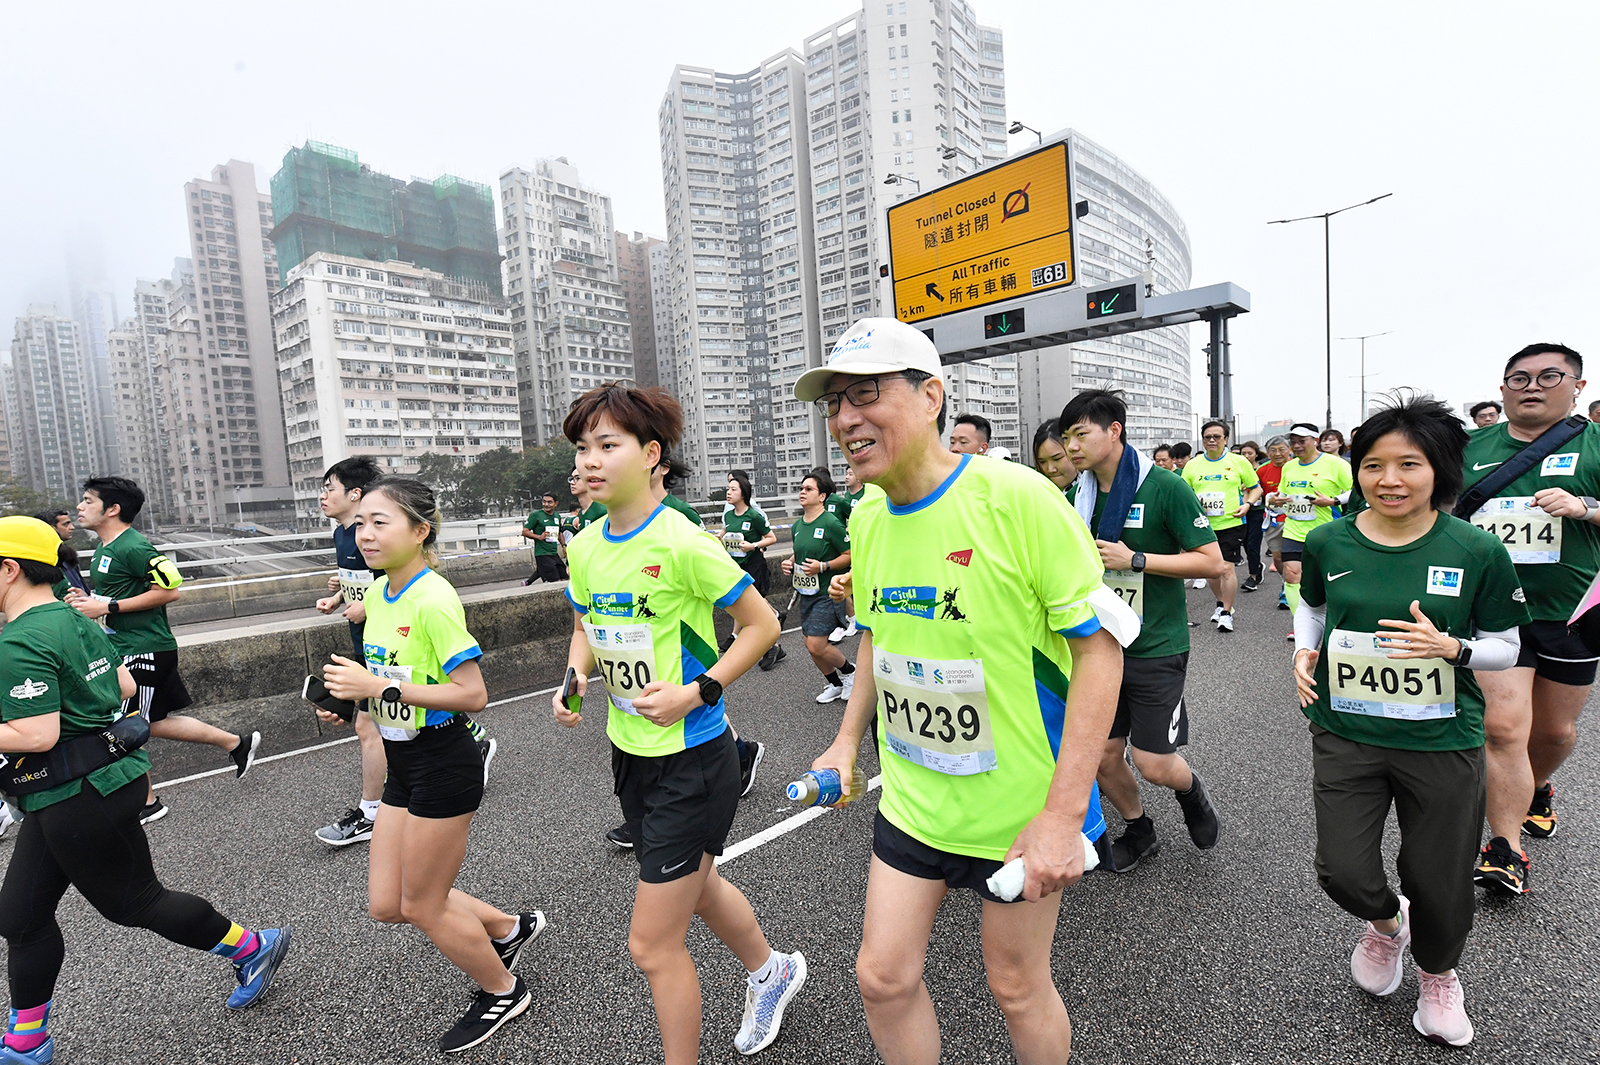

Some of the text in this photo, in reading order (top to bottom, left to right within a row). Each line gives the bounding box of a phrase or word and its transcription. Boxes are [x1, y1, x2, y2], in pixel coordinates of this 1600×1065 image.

[915, 191, 996, 229] Tunnel Closed
[924, 213, 989, 250] 隧道封閉
[952, 257, 1010, 281] All Traffic
[1043, 264, 1064, 283] 6B
[949, 272, 1017, 305] 所有車輛
[909, 304, 925, 316] km
[1475, 523, 1555, 544] 1214
[1336, 662, 1442, 696] P4051
[883, 689, 981, 744] P1239
[13, 768, 48, 785] naked
